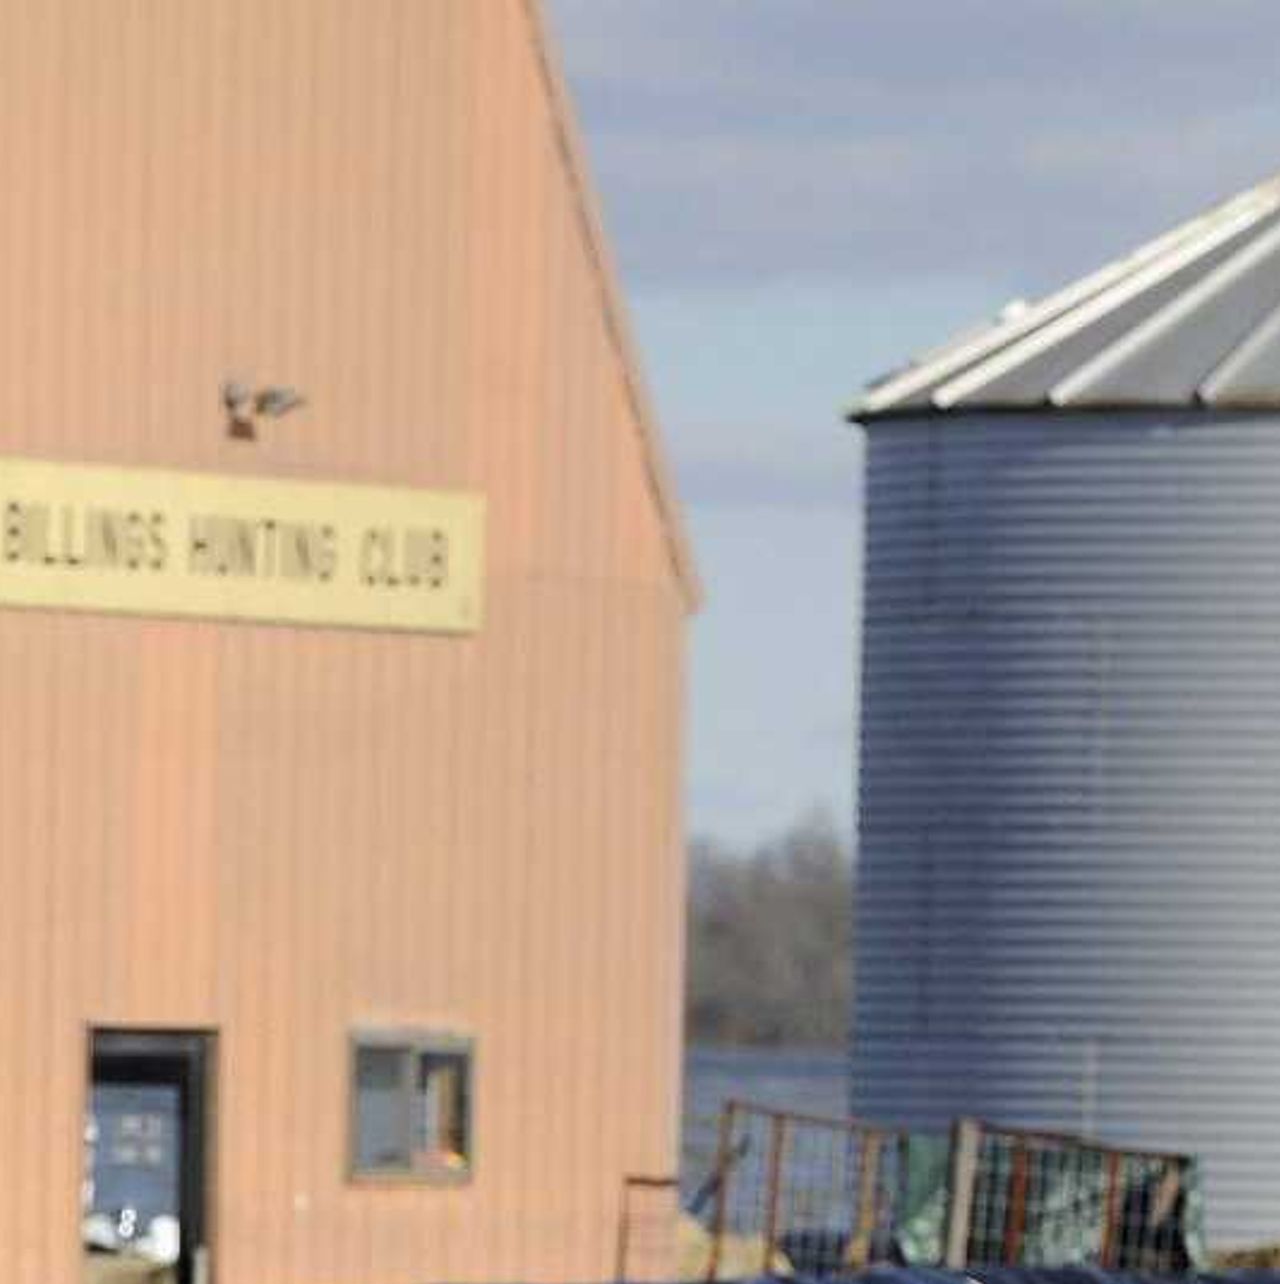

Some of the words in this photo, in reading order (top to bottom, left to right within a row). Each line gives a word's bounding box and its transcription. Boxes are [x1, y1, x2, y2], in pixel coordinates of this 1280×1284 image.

[3, 501, 166, 571] BILLINGS
[187, 513, 335, 583] HUNTING
[358, 527, 449, 589] CLUB
